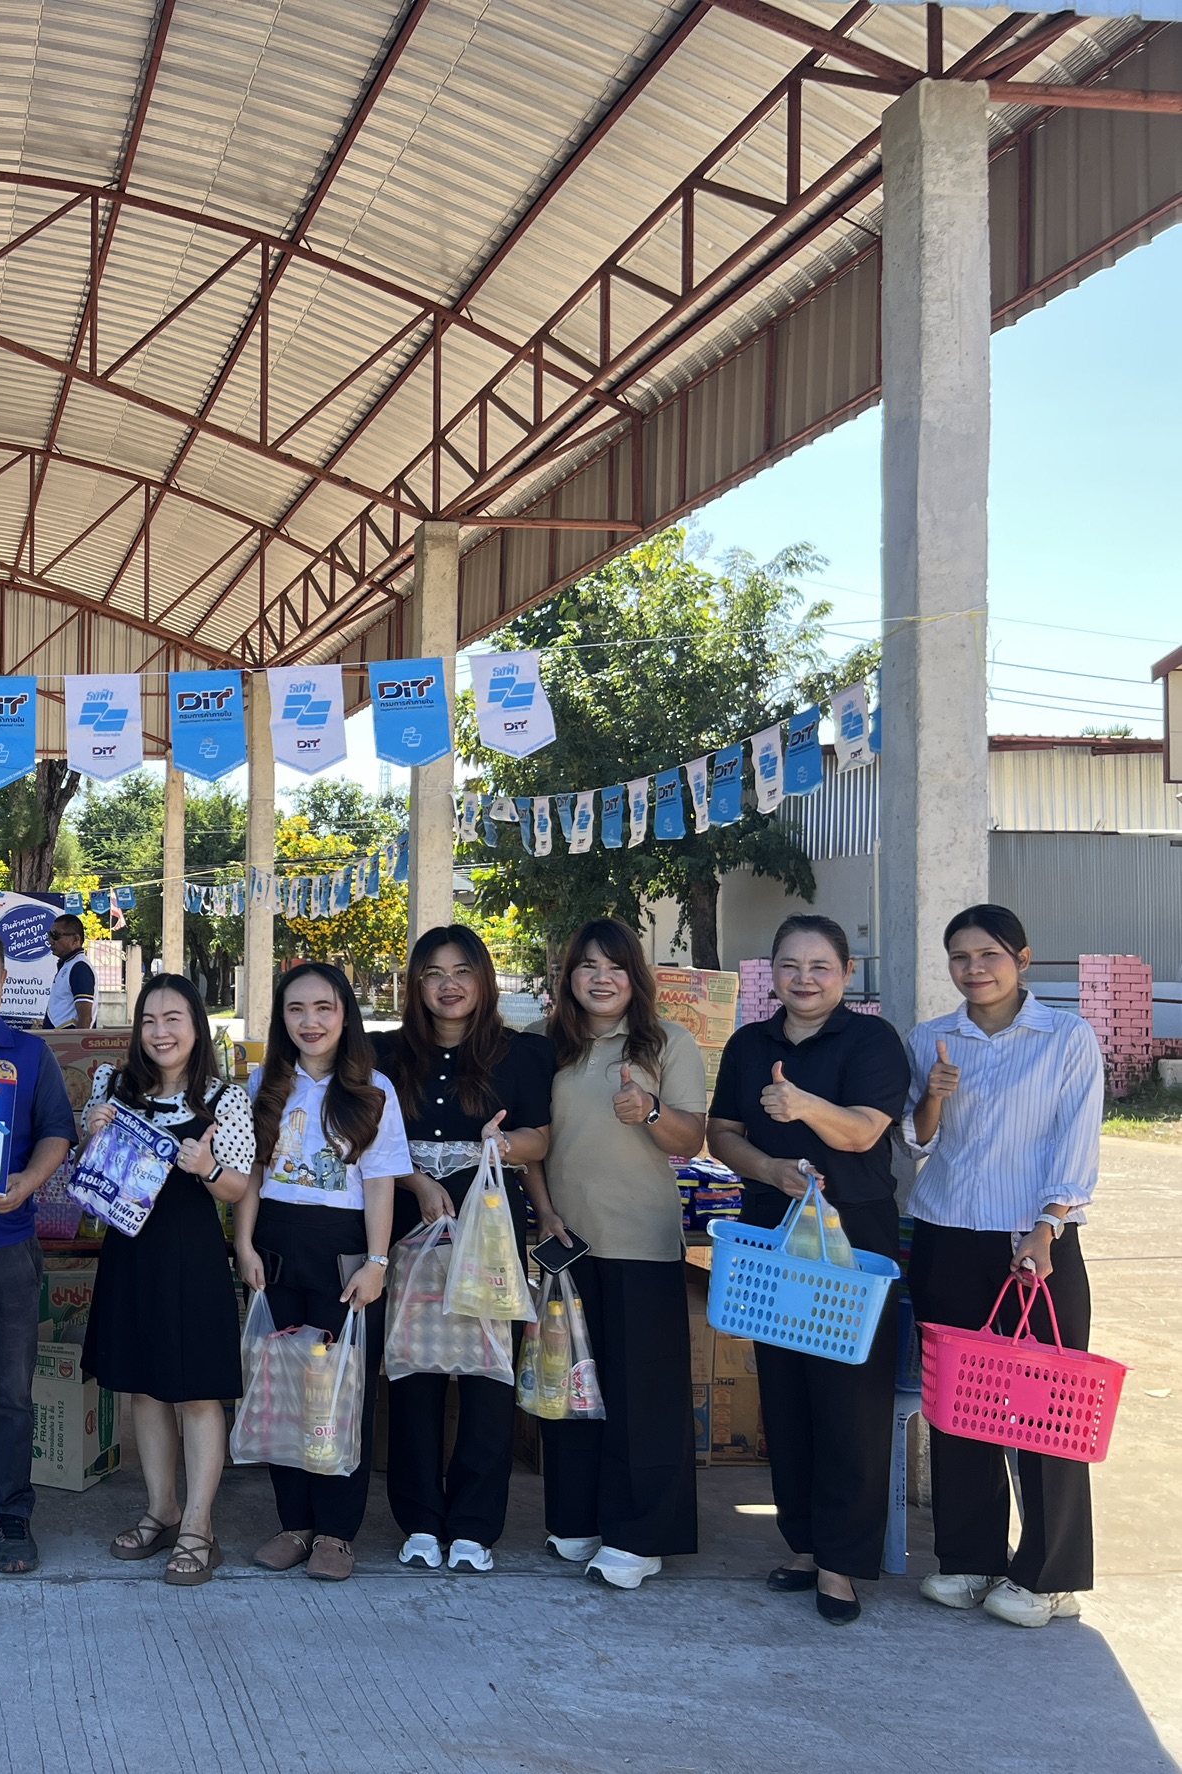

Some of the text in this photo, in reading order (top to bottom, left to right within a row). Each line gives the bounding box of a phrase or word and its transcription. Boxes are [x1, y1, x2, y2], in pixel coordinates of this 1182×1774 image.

[493, 663, 519, 676] ธงฟ้า
[289, 680, 316, 693] ธงฟ้า
[377, 675, 435, 700] DiT
[86, 688, 113, 701] ธงฟ้า
[177, 686, 235, 712] DiT
[380, 698, 434, 707] กรมการค้าภายใน
[178, 710, 232, 719] กรมการค้าภายใน
[504, 720, 528, 730] DiT
[297, 738, 321, 748] DiT
[92, 745, 117, 755] DiT
[2, 912, 47, 932] สินค้าคุณภาพ
[8, 922, 44, 941] ราคาถูก
[5, 976, 43, 986] ยังพบกับ
[3, 986, 51, 996] ภายในงานอี
[658, 990, 699, 1004] MAMA
[88, 1037, 130, 1048] รสต้มยำก
[115, 1109, 154, 1143] ยดีอันดับ
[78, 1171, 115, 1195] หอมคุ้ม
[113, 1200, 146, 1222] แพ็ค 3
[57, 1421, 64, 1431] ml
